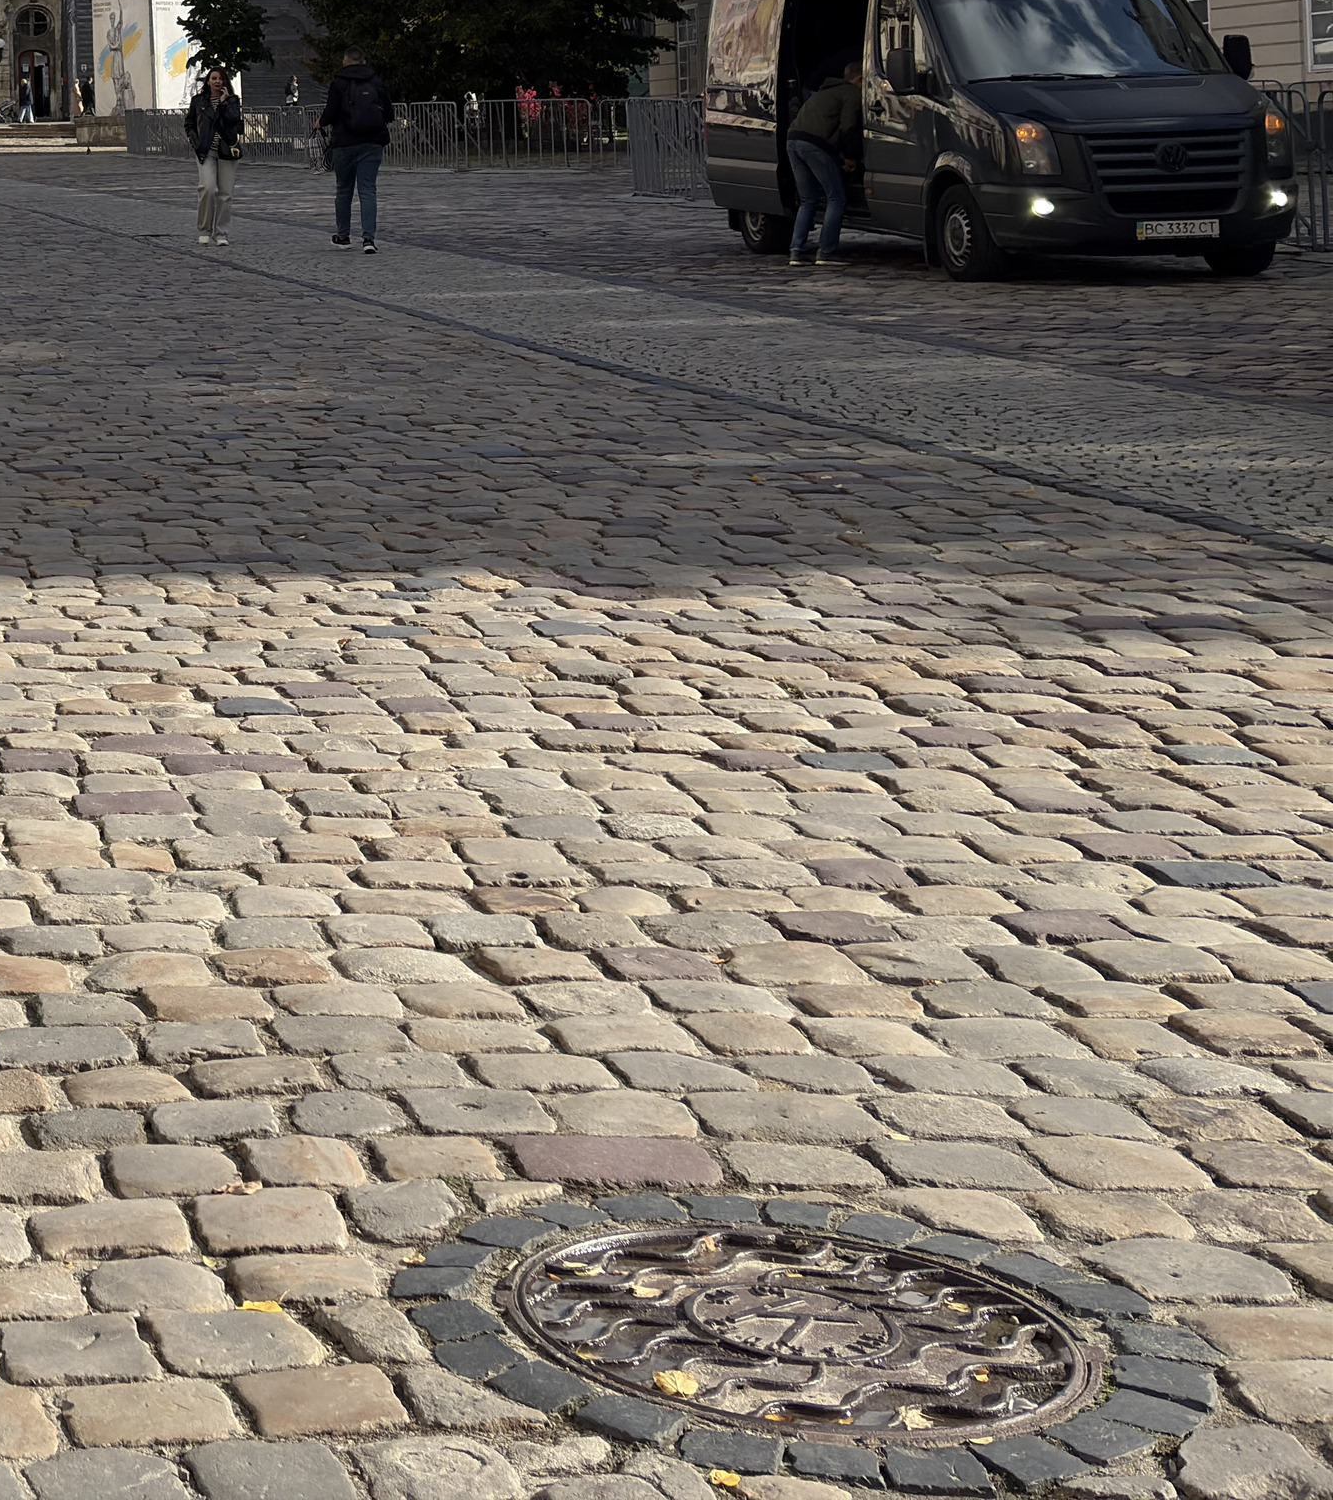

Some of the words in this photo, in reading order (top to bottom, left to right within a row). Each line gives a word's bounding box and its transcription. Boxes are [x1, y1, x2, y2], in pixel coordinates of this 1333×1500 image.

[1145, 223, 1164, 235] BC
[1167, 222, 1195, 234] 3332
[1199, 221, 1217, 233] CT
